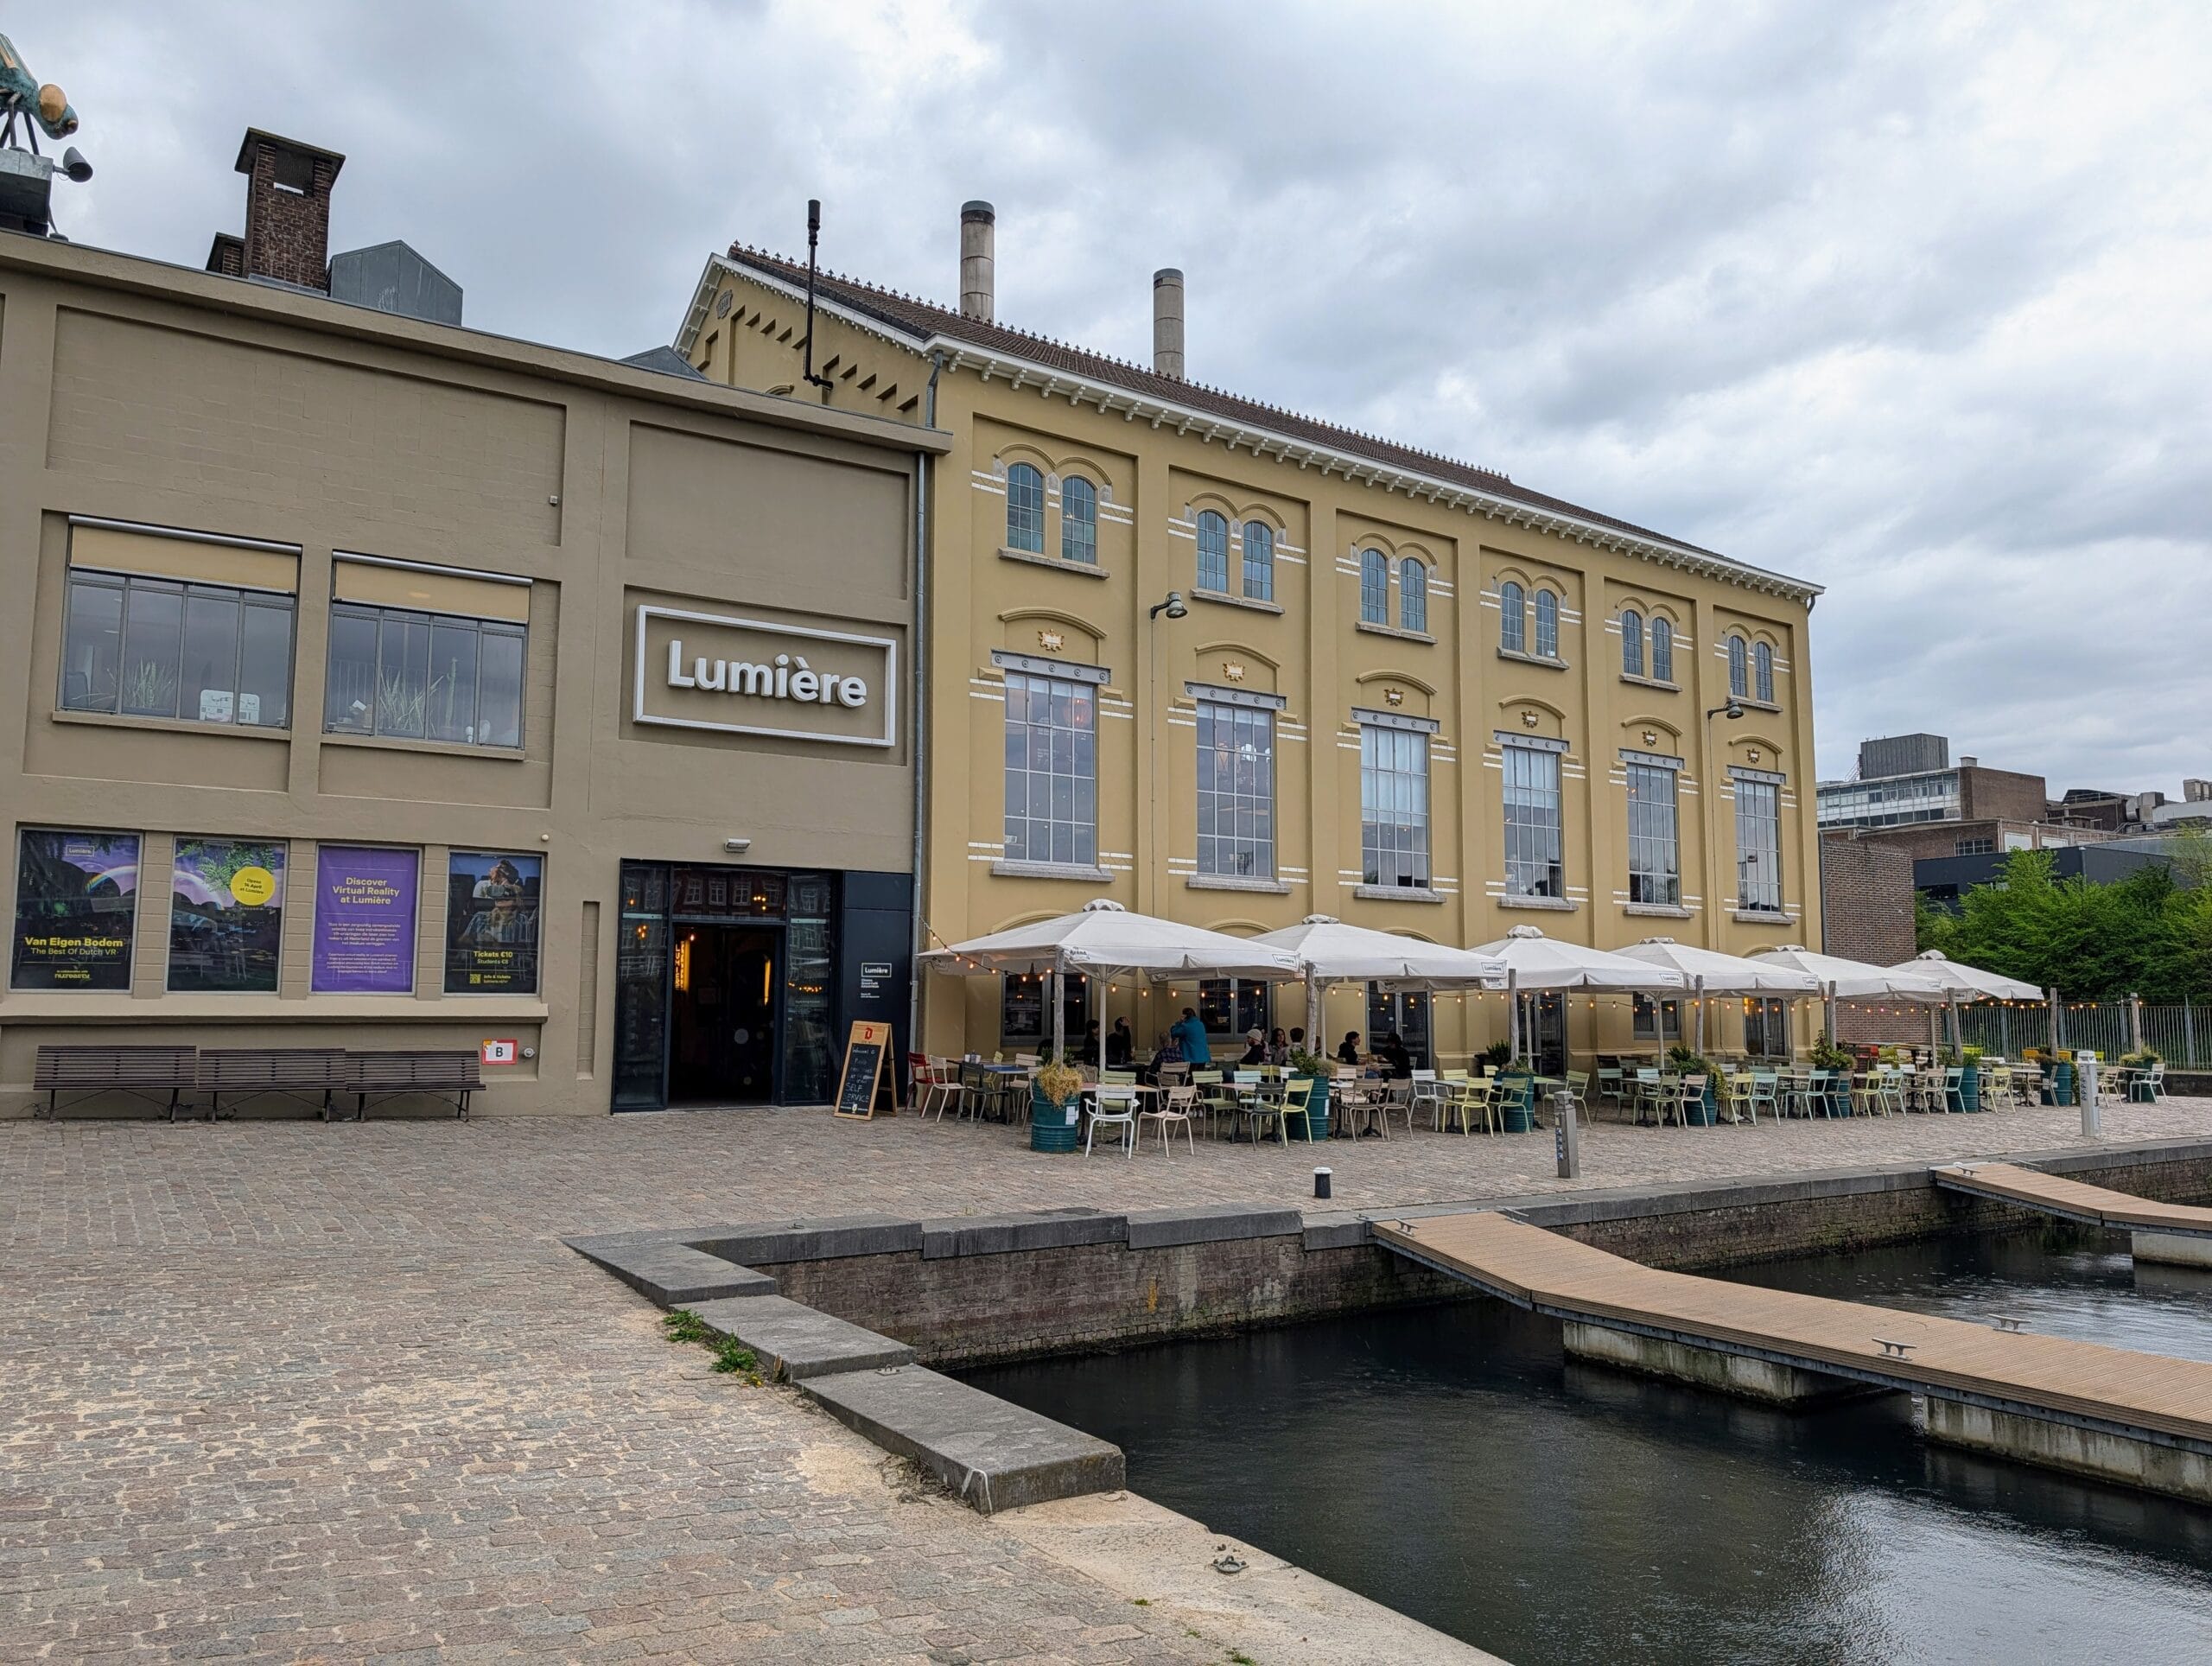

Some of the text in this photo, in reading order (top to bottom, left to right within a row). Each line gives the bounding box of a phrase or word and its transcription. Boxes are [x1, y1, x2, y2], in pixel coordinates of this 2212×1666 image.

[668, 639, 868, 708] Lumière
[346, 877, 387, 886] Discover
[333, 886, 400, 897] Virtual Reality
[353, 895, 391, 905] Lumière
[24, 937, 123, 948] Van Eigen Bodem
[495, 1046, 504, 1057] B
[845, 1082, 863, 1093] SELF
